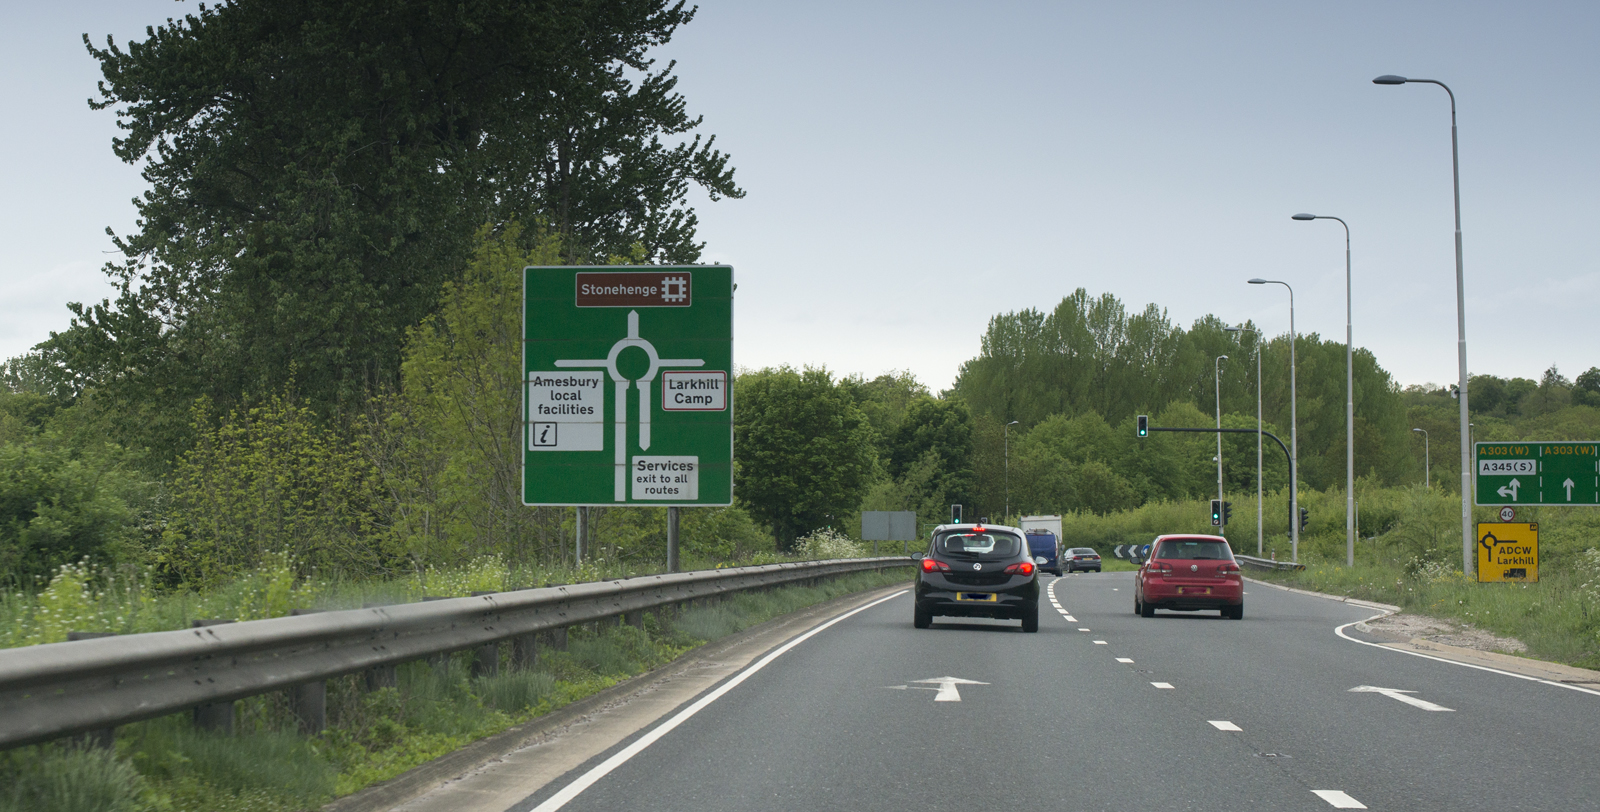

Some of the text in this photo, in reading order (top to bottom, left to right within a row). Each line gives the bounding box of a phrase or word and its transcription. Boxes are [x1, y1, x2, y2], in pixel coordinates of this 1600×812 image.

[581, 284, 657, 297] Stonehenge
[534, 376, 599, 388] Amesbury
[669, 379, 719, 390] Larkhill
[550, 390, 582, 400] local
[674, 393, 713, 405] Camp
[538, 404, 594, 414] facilities
[1480, 446, 1529, 455] A303(W)
[1545, 445, 1595, 455] A303(W)
[637, 460, 694, 471] Services
[1483, 462, 1533, 472] A345(S)
[636, 474, 688, 483] exit to all
[645, 486, 679, 494] routes
[1499, 546, 1532, 554] ADCW
